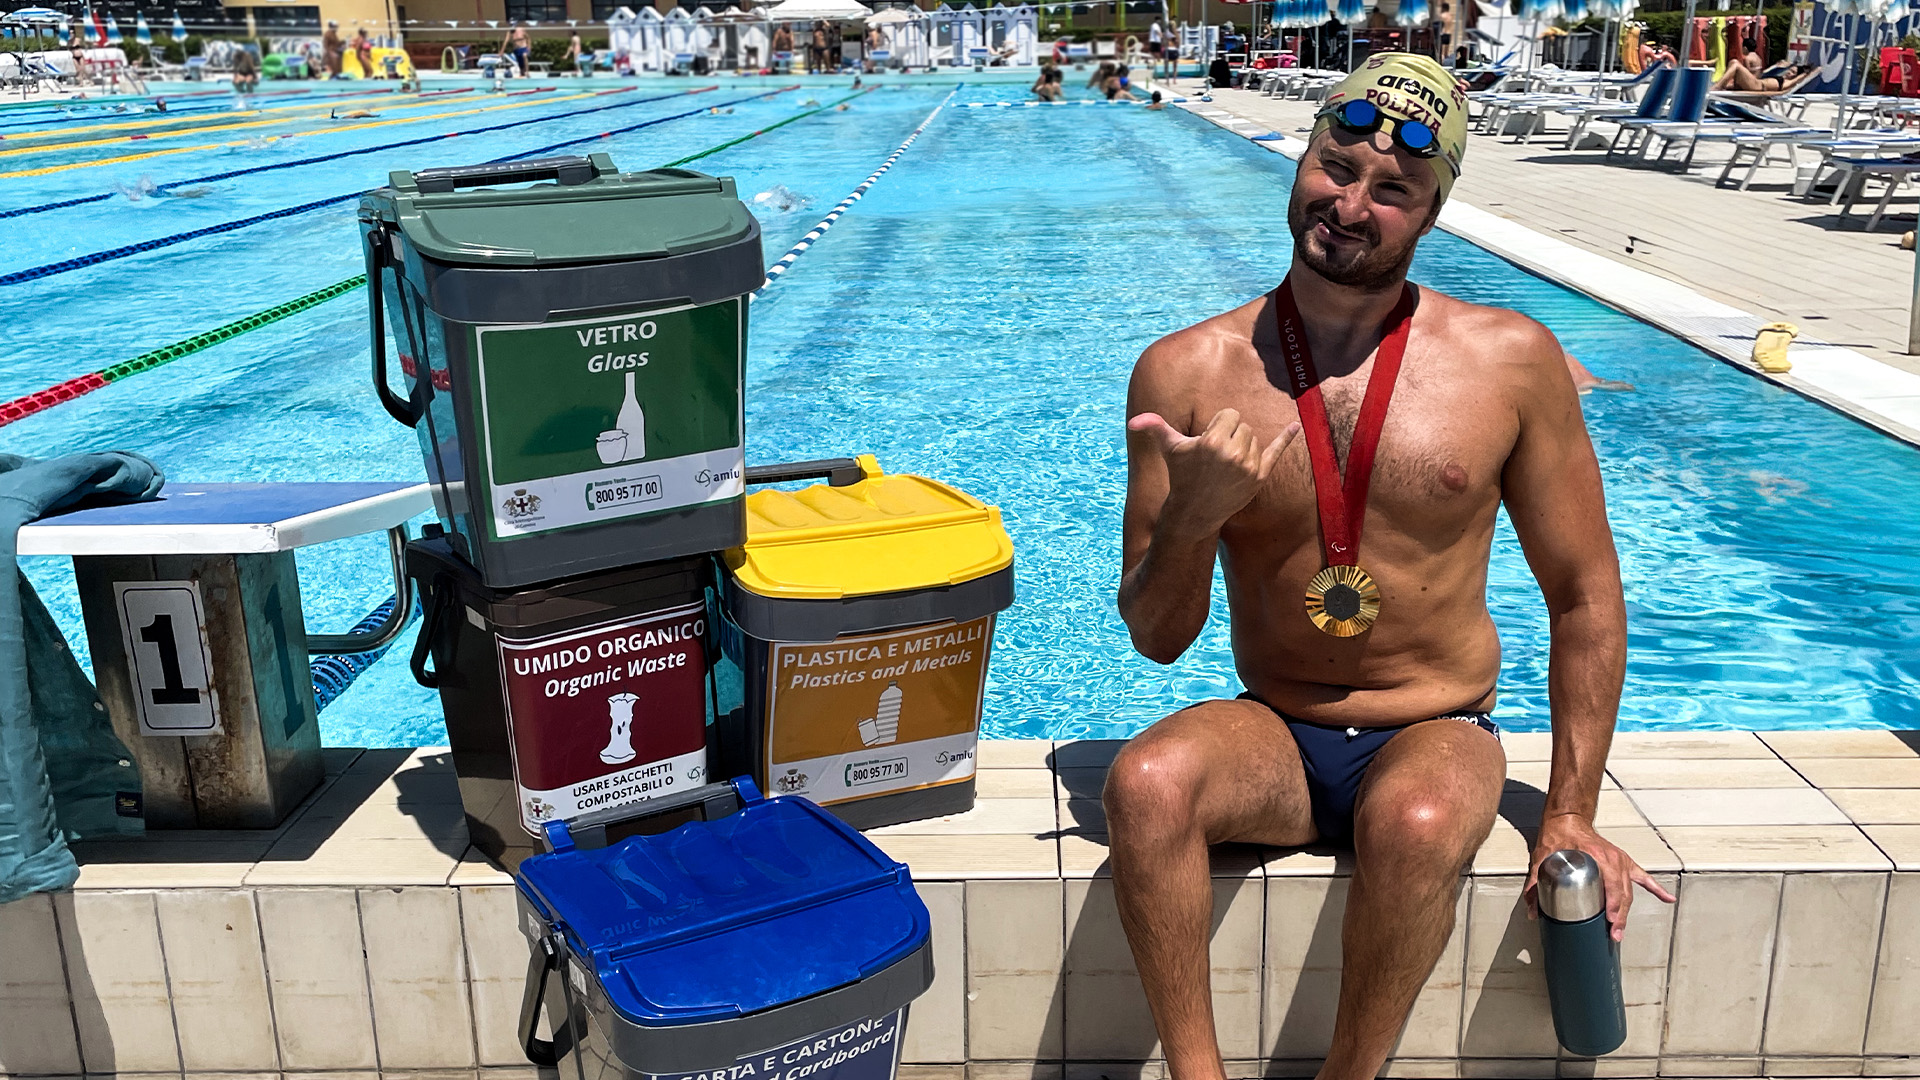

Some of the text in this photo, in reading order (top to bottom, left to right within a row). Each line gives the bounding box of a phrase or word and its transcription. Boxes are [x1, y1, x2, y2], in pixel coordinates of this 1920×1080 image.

[1365, 88, 1442, 136] POLIZIA
[1377, 75, 1448, 119] arena
[576, 320, 658, 348] VETRO
[1284, 318, 1309, 389] PARIS 2024
[587, 352, 650, 373] Glass
[596, 481, 658, 503] 800 95 77 00
[713, 468, 740, 482] amiu
[140, 614, 201, 705] 1
[513, 618, 705, 676] UMIDO ORGANICO
[783, 625, 984, 669] PLASTICA E METALLI
[544, 652, 687, 698] Organic Waste
[790, 649, 973, 690] Plastics and Metals
[853, 763, 904, 781] 800 95 77 00
[950, 750, 973, 762] amiu
[572, 762, 674, 798] USARE SACCHETTI
[577, 780, 663, 811] COMPOSTABILI
[665, 775, 675, 786] O
[763, 1056, 777, 1072] E
[782, 1018, 883, 1065] CARTONE
[785, 1026, 895, 1080] Cardboard
